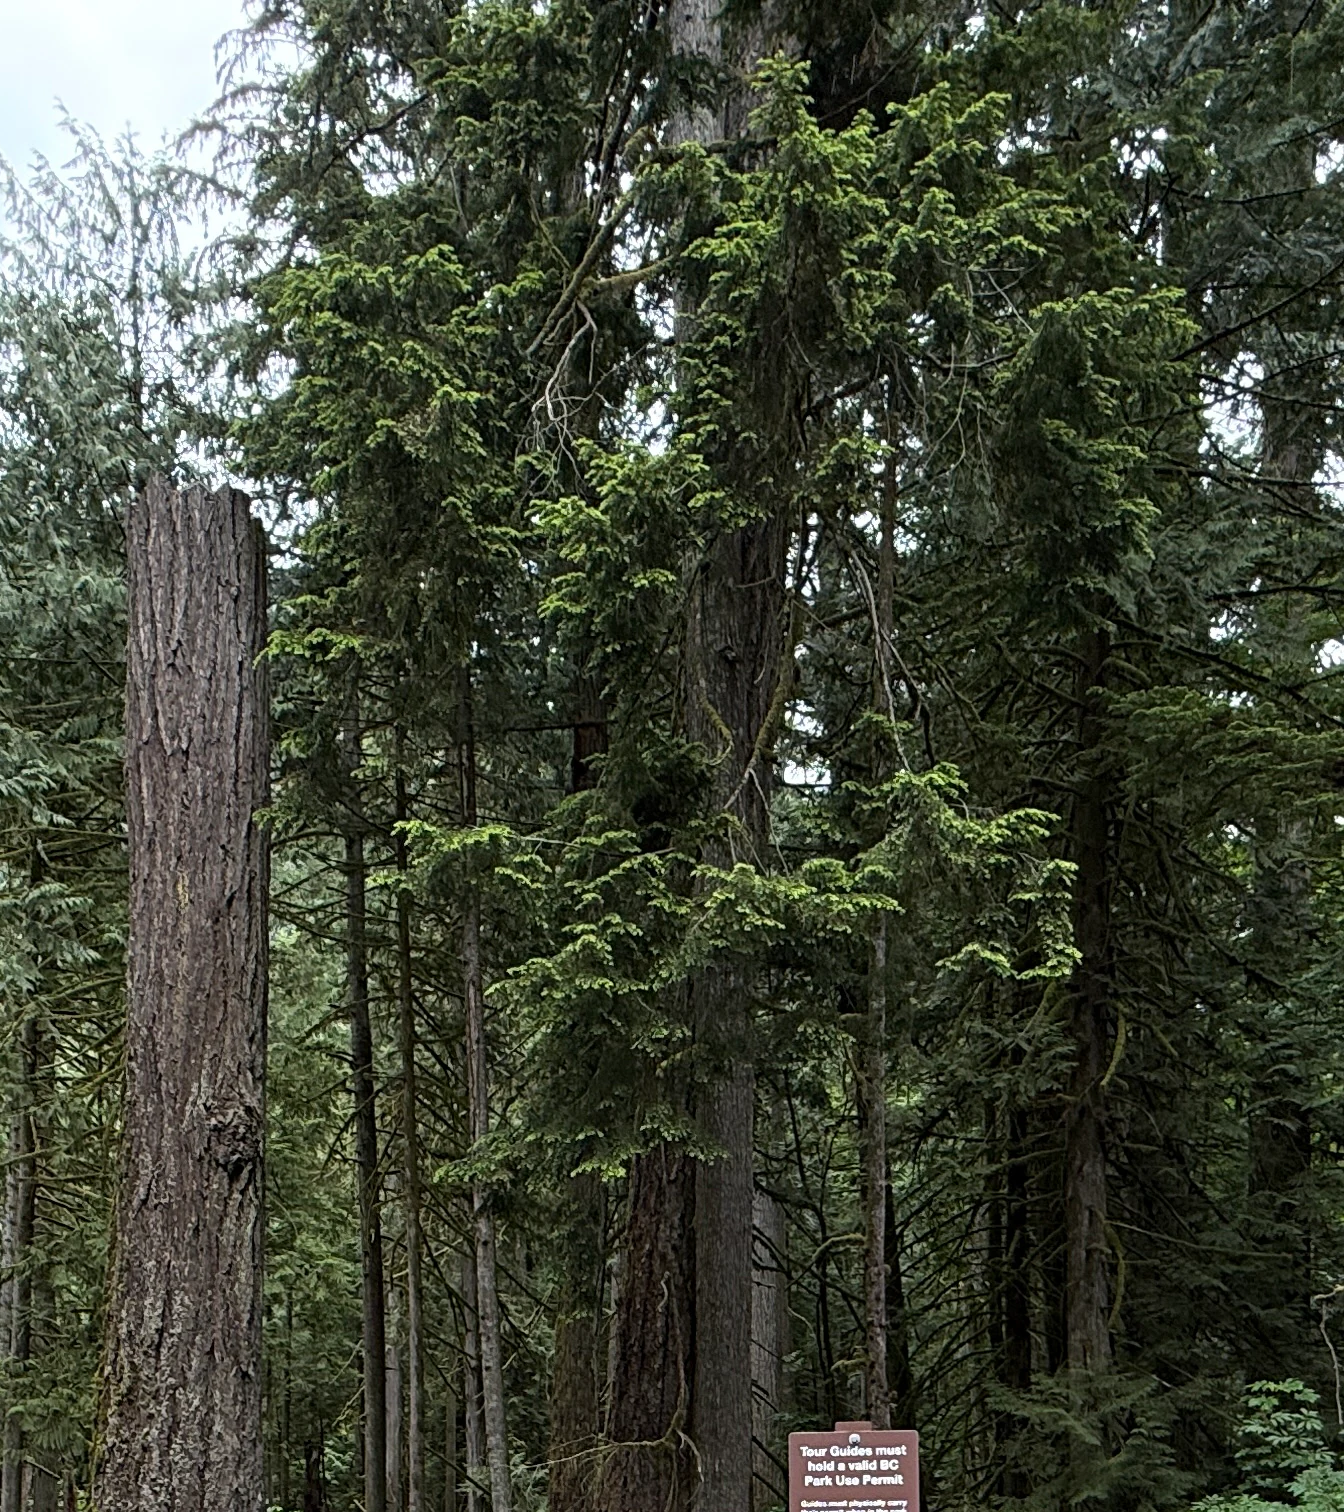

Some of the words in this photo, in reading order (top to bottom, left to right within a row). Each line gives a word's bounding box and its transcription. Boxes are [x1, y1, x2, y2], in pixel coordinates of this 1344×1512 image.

[799, 1446, 827, 1457] Tour
[830, 1445, 873, 1457] Guides
[876, 1445, 907, 1456] must
[807, 1460, 835, 1471] hold
[837, 1463, 846, 1471] a
[848, 1460, 877, 1471] valid
[880, 1459, 899, 1471] BC
[804, 1475, 833, 1486] Park
[835, 1474, 860, 1486] Use
[862, 1474, 904, 1485] Permit
[848, 1499, 886, 1507] physically
